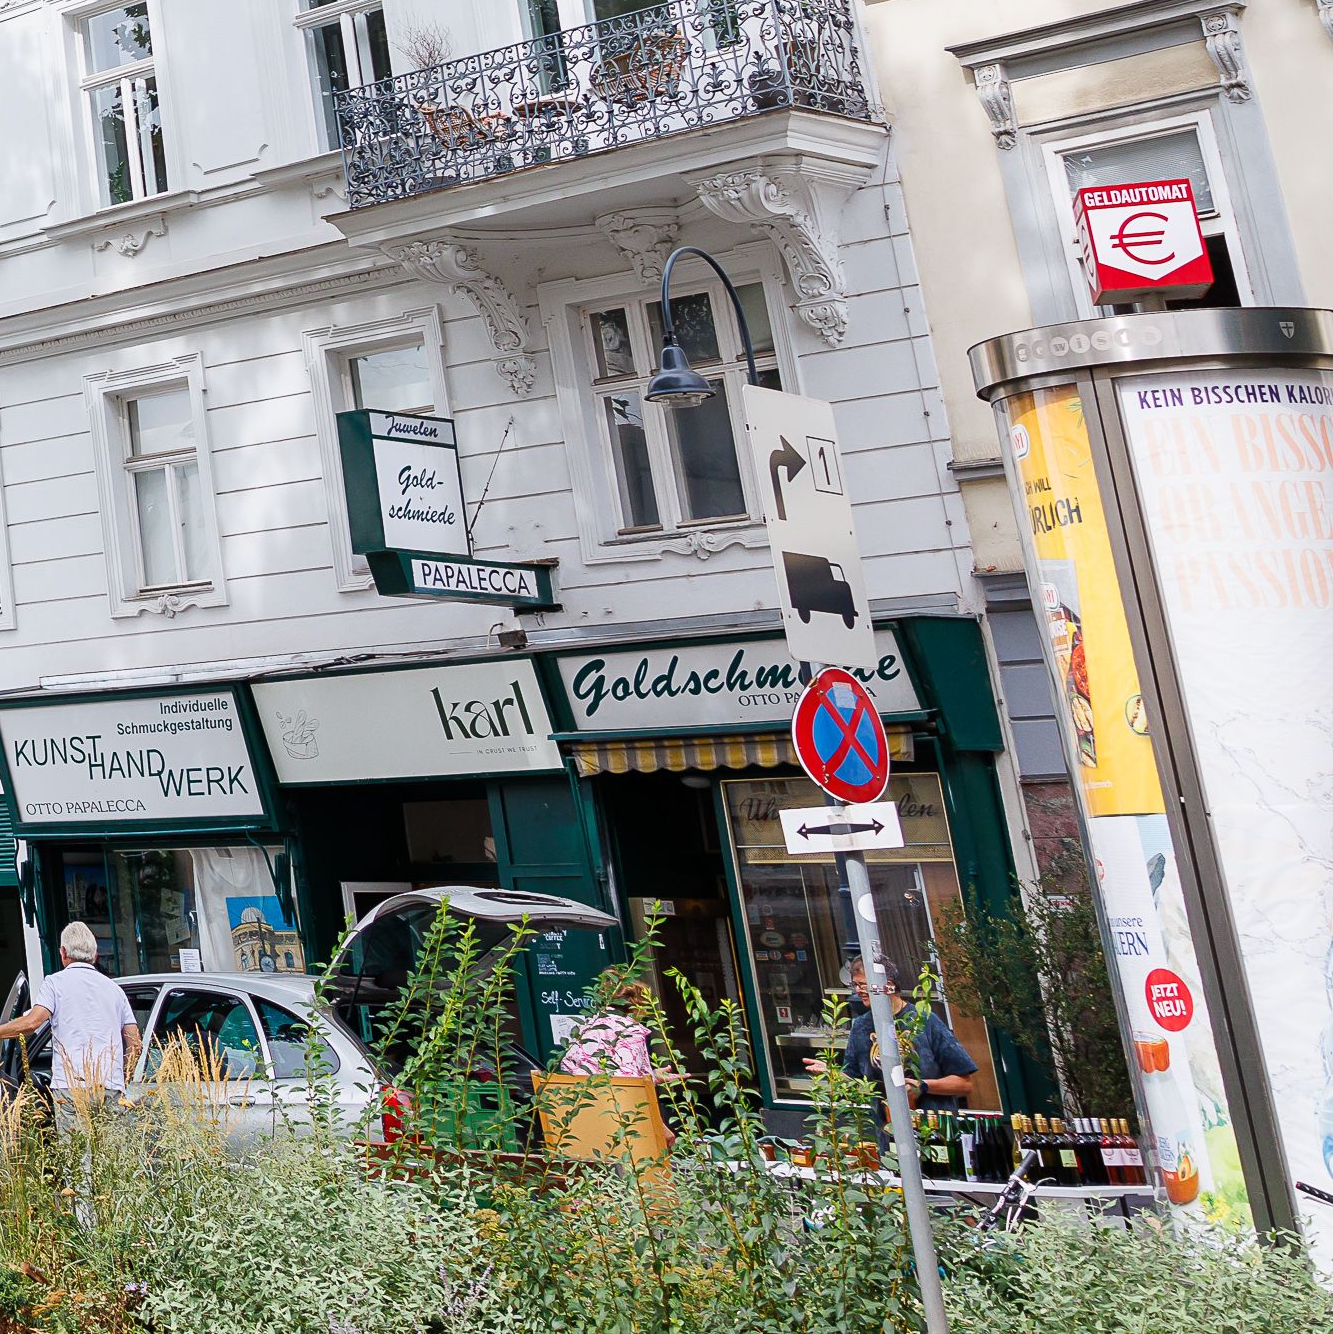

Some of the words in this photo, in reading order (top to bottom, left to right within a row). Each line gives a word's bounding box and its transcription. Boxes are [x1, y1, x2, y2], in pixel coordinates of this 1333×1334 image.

[1084, 184, 1188, 207] GELDAUTOMAT
[1137, 388, 1184, 409] KEIN
[1191, 384, 1281, 406] BISSCHEN
[1285, 384, 1333, 407] KALOR
[385, 415, 438, 438] Juwelen
[1143, 416, 1222, 477] EIN
[818, 446, 831, 485] 1
[398, 465, 444, 495] Gold-
[1034, 477, 1052, 494] WILL
[388, 498, 456, 525] schmiede
[1029, 496, 1083, 536] ÜRLICH
[421, 562, 531, 595] PAPALECCA
[1173, 547, 1333, 613] PASSIO
[159, 698, 229, 715] Individuelle
[430, 680, 535, 740] karl
[738, 692, 780, 707] OTTO
[116, 716, 233, 735] Schmuckgestaltung
[14, 735, 102, 767] KUNST
[518, 745, 538, 753] TRUST
[88, 748, 166, 780] HAND
[157, 765, 249, 797] WERK
[26, 802, 63, 816] OTTO
[66, 799, 146, 814] PAPALECCA
[1151, 983, 1178, 1000] JETZT
[1153, 999, 1187, 1018] NEU!
